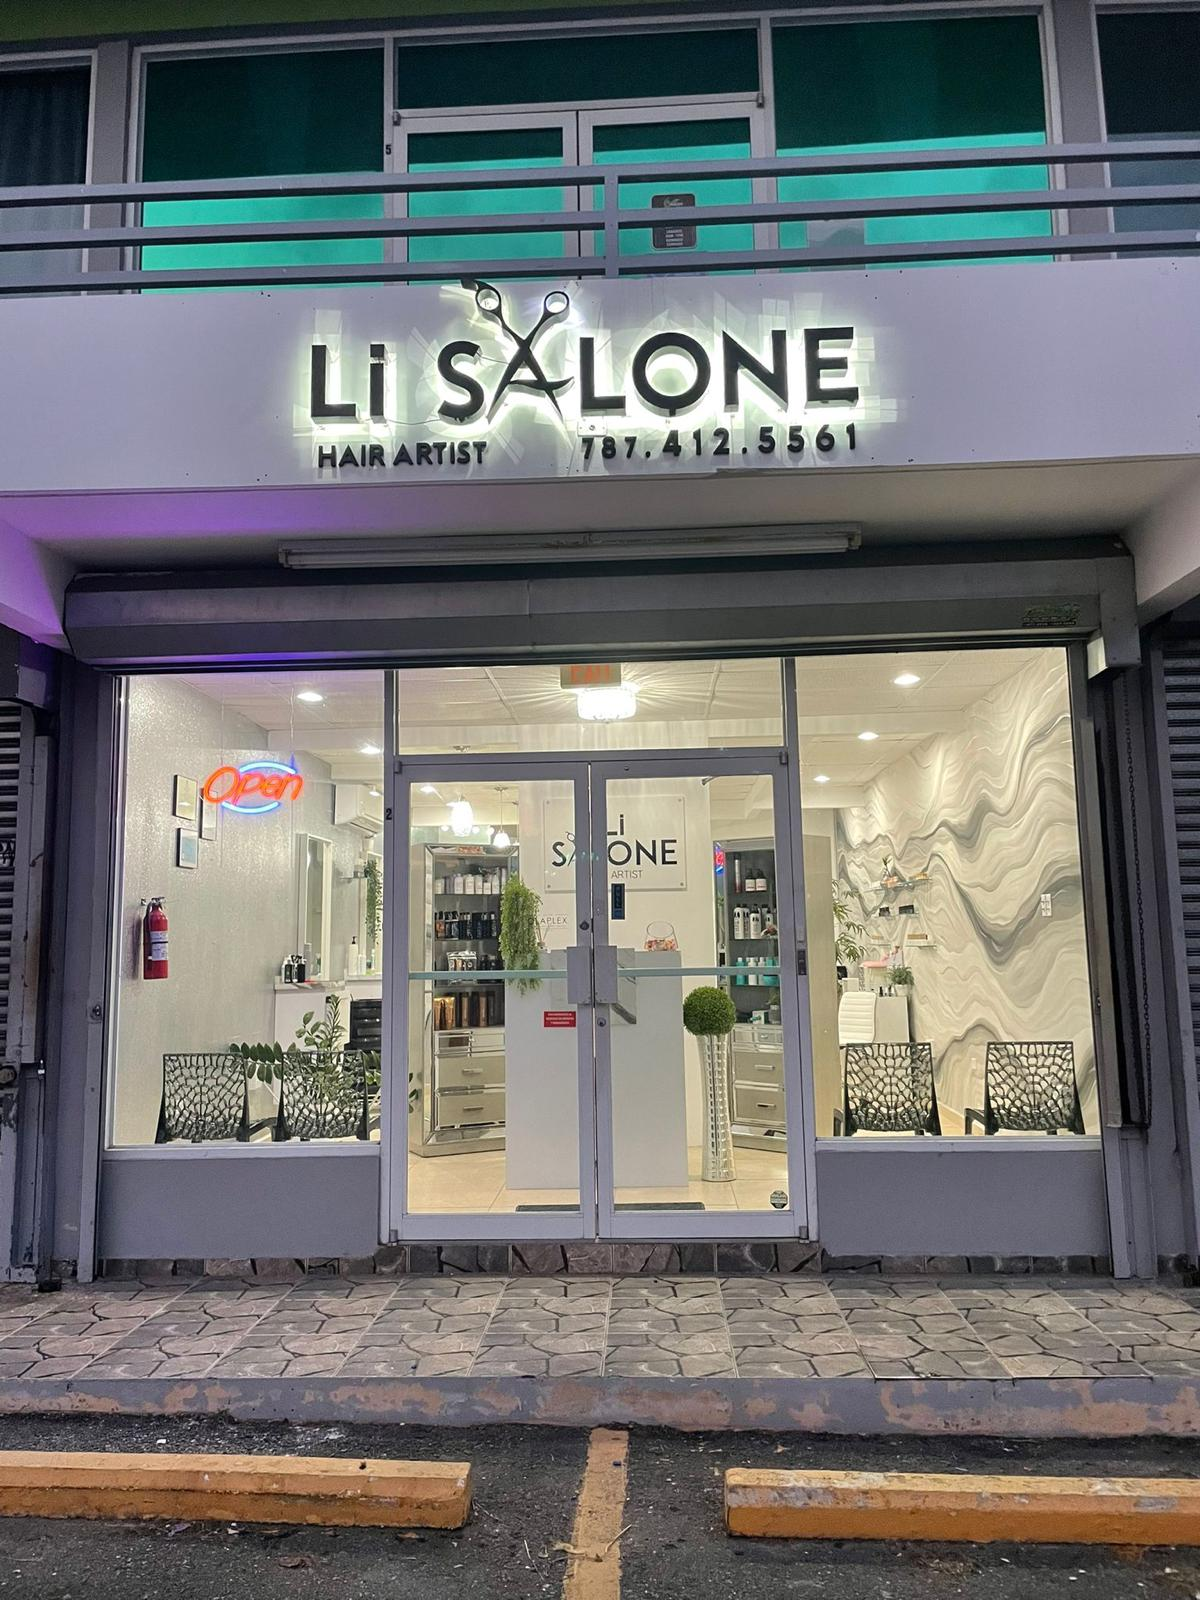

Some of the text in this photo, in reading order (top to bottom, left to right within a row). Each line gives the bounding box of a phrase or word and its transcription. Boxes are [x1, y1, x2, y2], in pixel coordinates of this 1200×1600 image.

[385, 144, 392, 155] 5
[310, 279, 860, 423] Li SALONE
[318, 440, 487, 468] HAIR ARTIST
[581, 422, 856, 460] 787.412.5561
[203, 766, 304, 805] Open
[385, 807, 392, 820] 2
[607, 814, 624, 836] i
[552, 838, 678, 867] SONE
[611, 869, 643, 879] ARTIST
